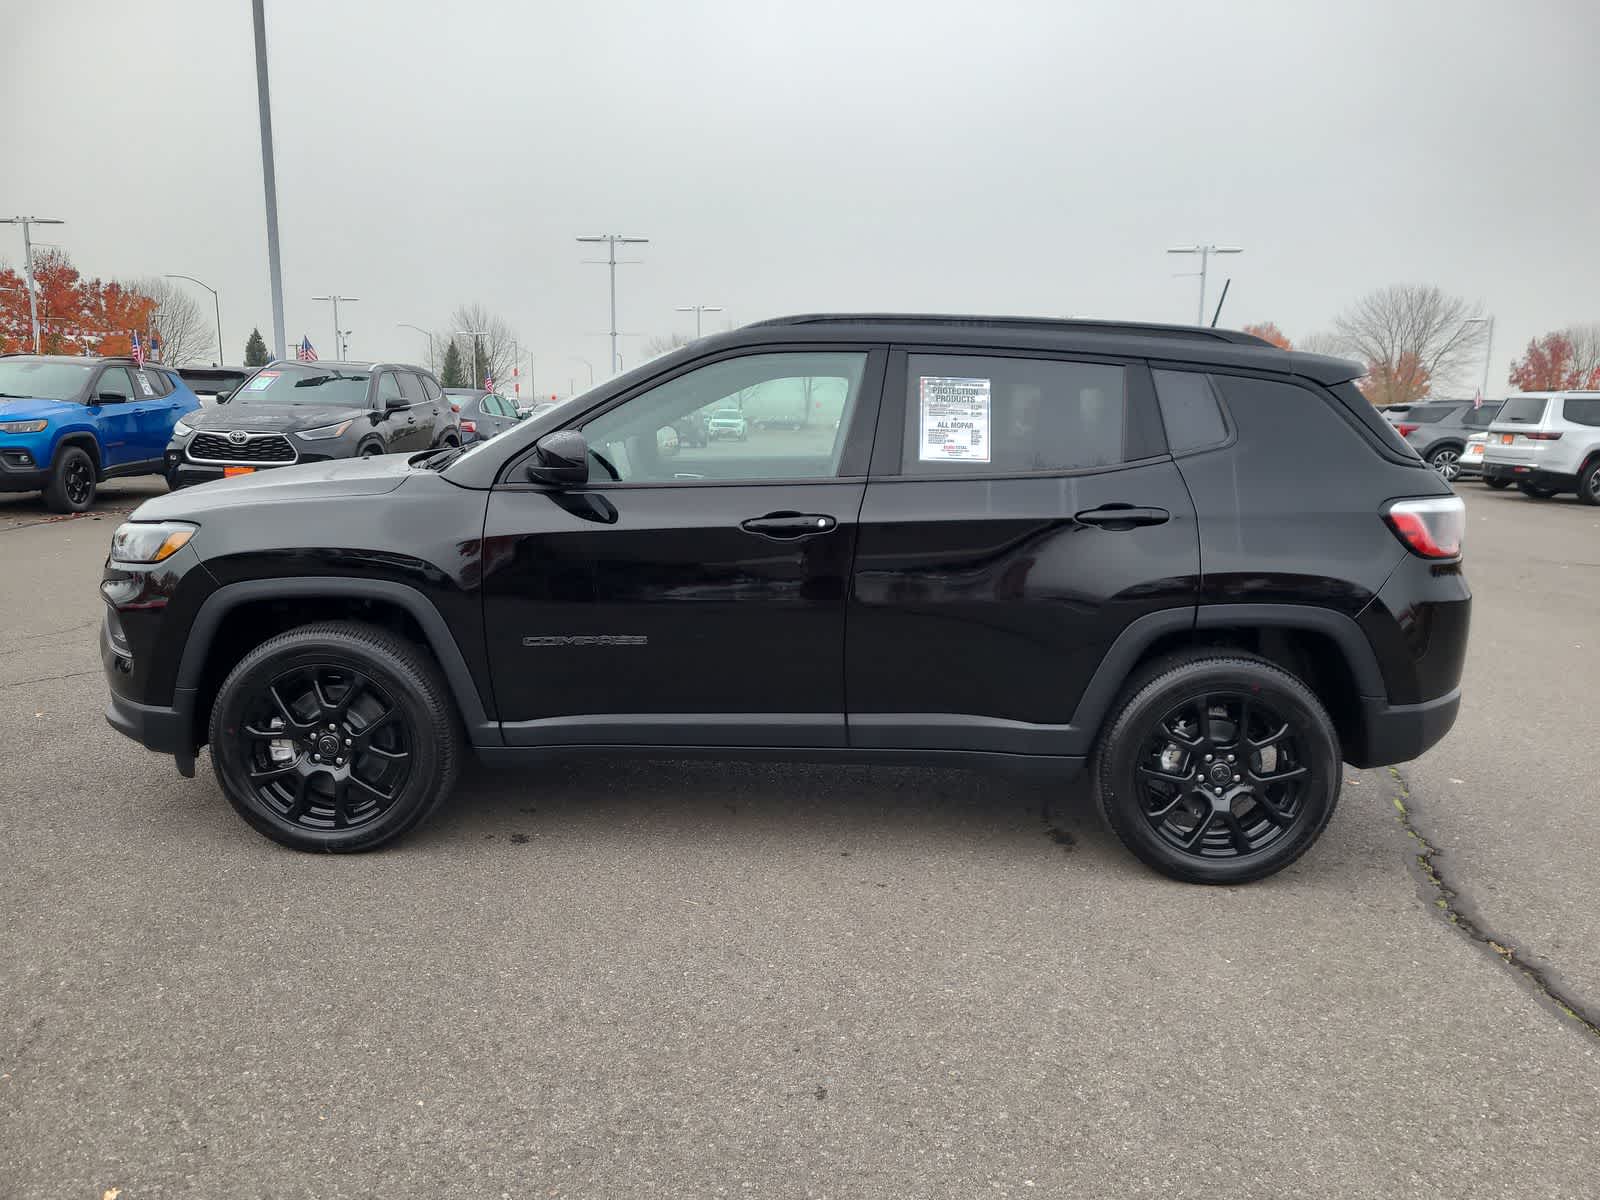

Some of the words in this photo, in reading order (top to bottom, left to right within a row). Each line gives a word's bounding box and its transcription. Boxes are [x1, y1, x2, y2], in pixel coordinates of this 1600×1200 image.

[932, 387, 979, 395] PROTECTION
[936, 395, 975, 403] PRODUCTS
[522, 635, 648, 646] COMPASS
